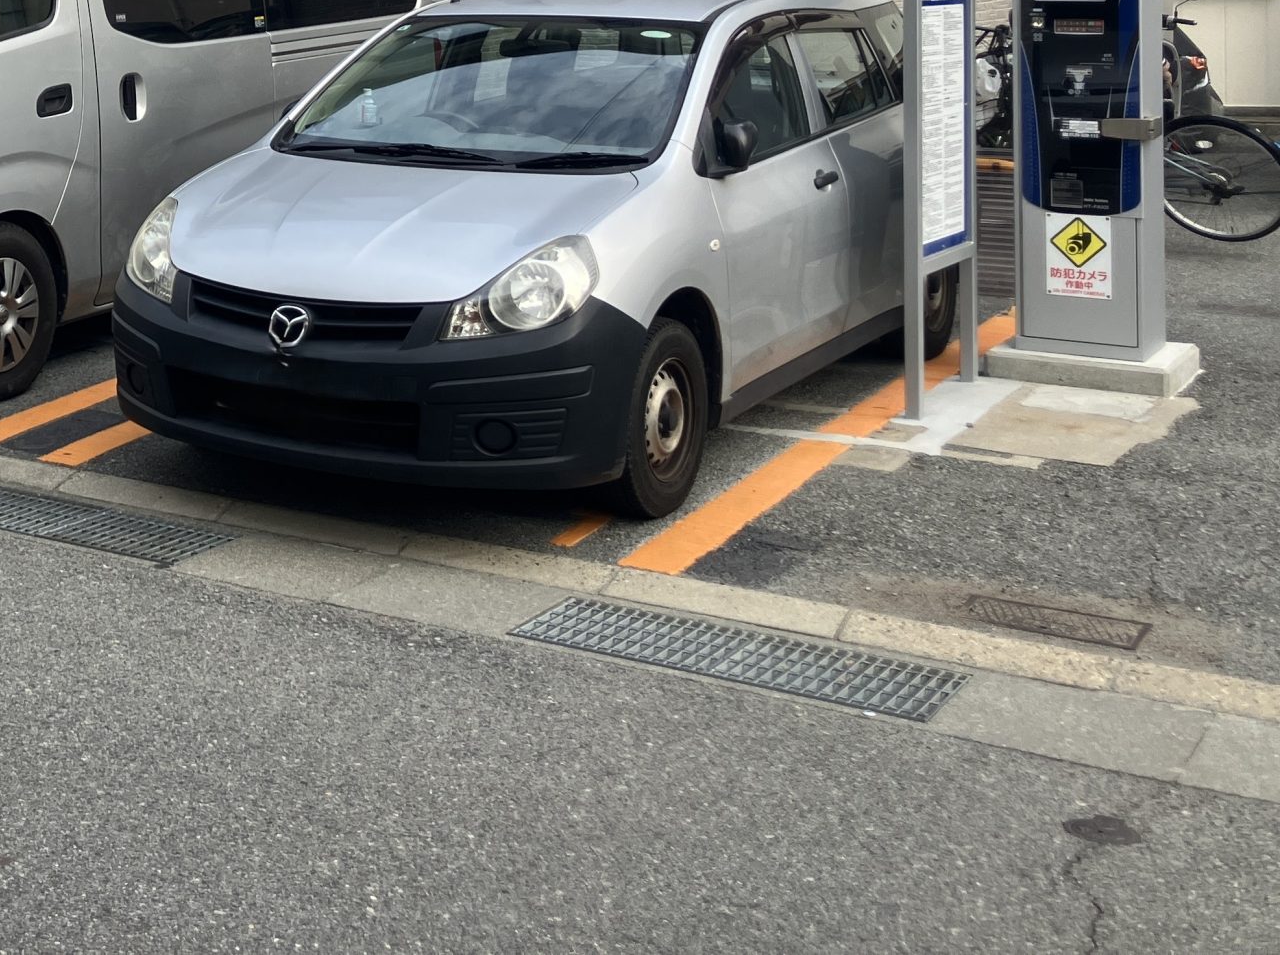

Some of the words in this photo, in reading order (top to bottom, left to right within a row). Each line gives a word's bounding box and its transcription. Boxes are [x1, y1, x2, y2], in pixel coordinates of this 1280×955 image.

[1050, 267, 1108, 282] 防犯カメラ
[1065, 279, 1093, 290] 作動中
